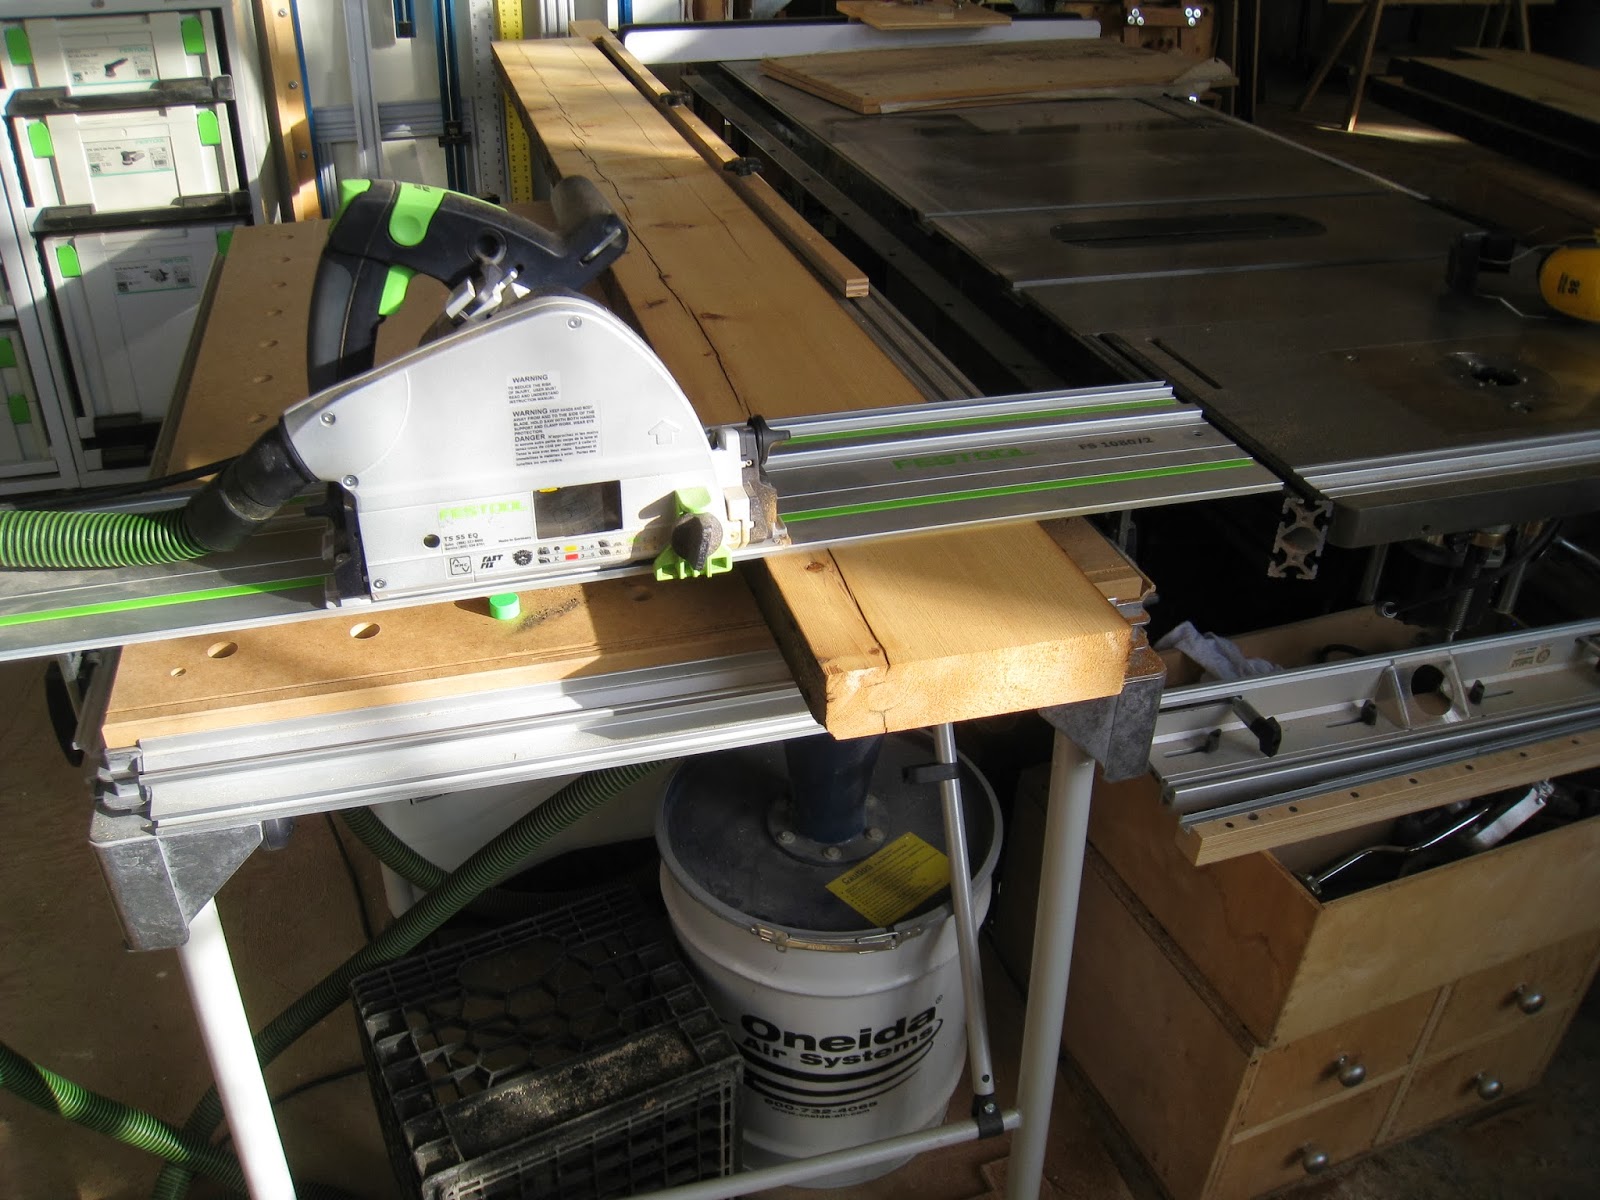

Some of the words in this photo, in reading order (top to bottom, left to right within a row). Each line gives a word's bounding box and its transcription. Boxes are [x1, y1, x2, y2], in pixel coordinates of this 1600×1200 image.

[512, 374, 548, 383] WARNING
[513, 408, 547, 417] WARNING
[515, 434, 545, 442] DANGER
[439, 501, 528, 520] FESTOOL
[842, 864, 873, 884] Caution
[741, 1007, 936, 1052] Oneida
[742, 1036, 787, 1058] Air
[800, 1026, 933, 1068] Systems
